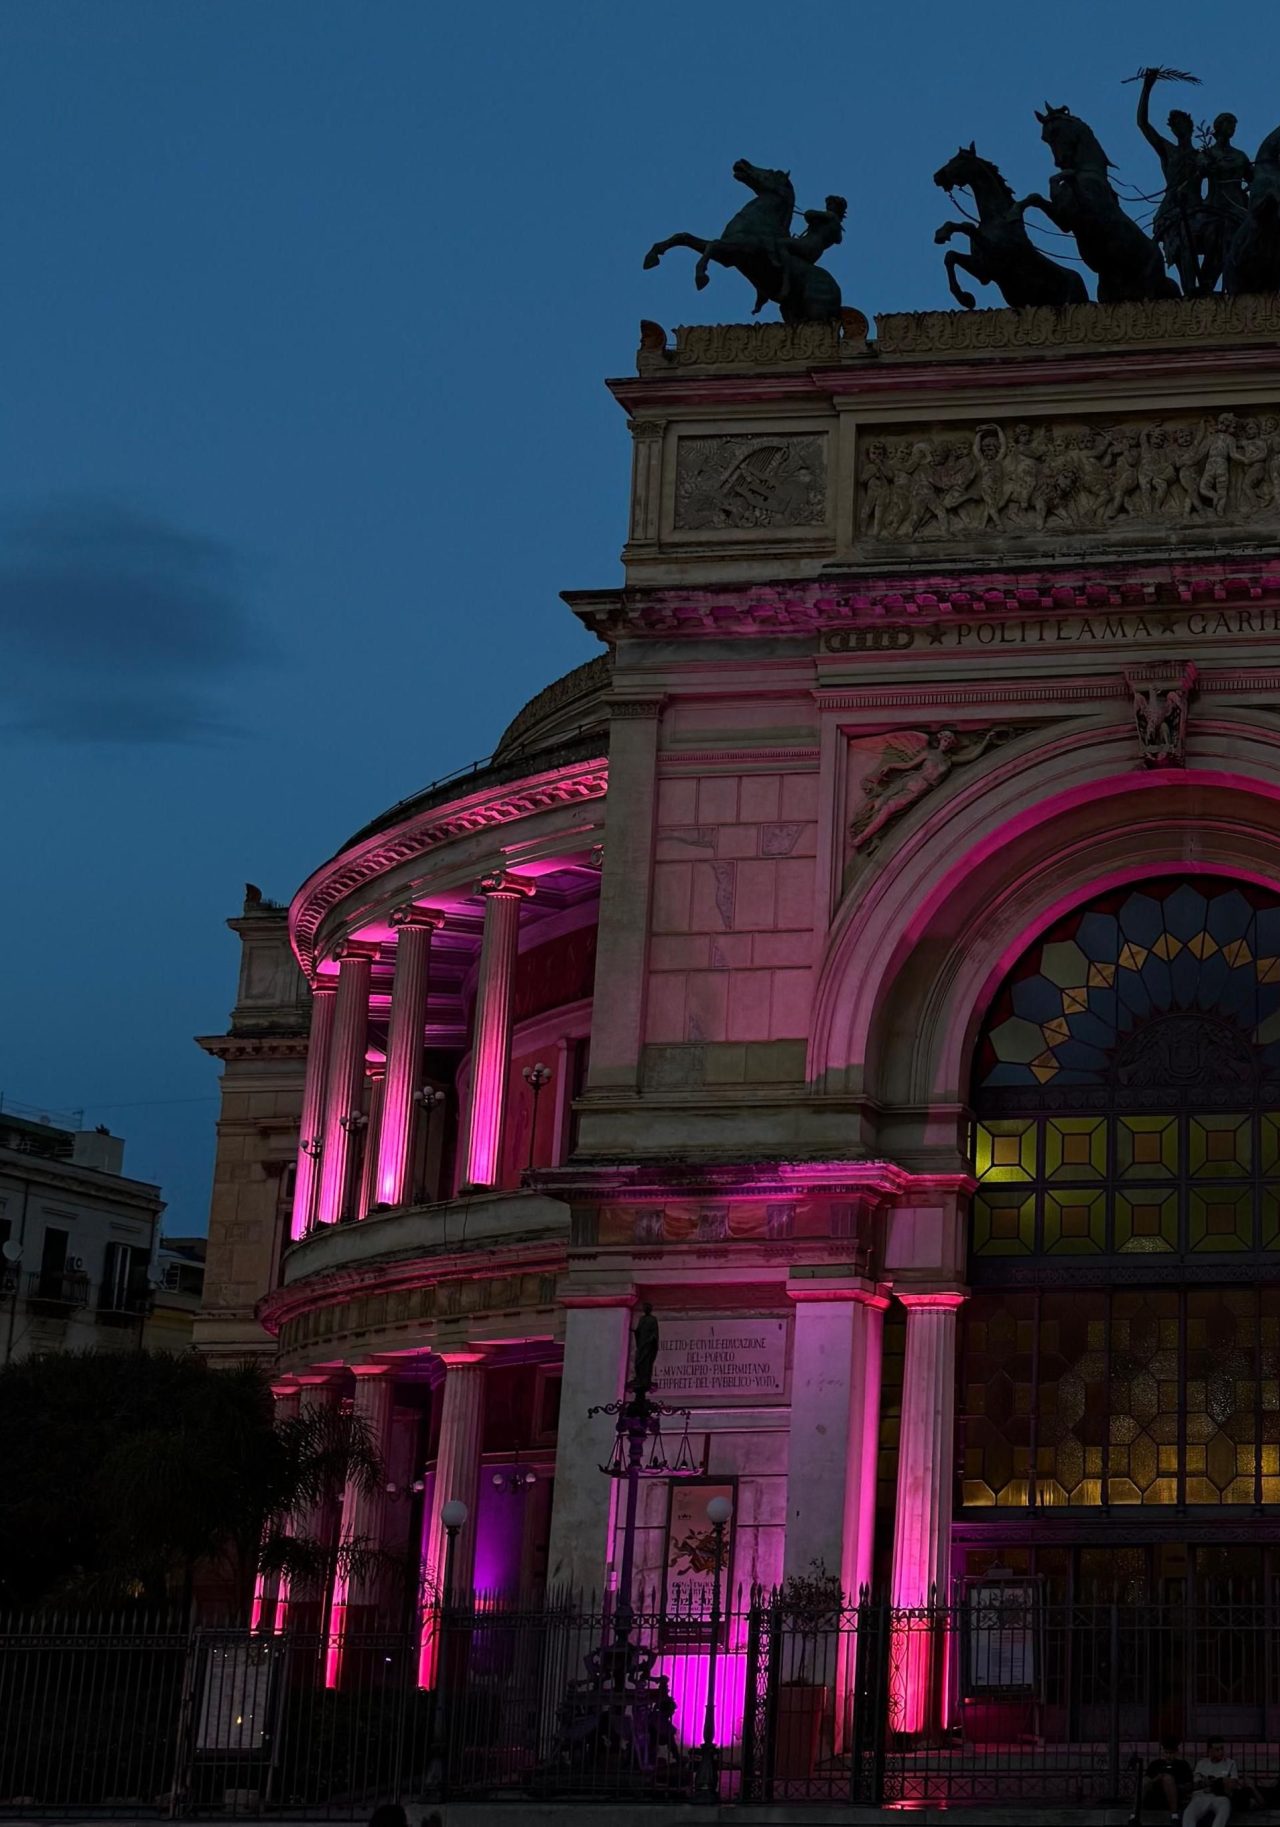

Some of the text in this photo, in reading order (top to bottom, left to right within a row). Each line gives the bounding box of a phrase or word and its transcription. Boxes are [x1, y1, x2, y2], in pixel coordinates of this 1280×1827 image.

[955, 615, 1153, 646] POLITEAMA
[663, 1363, 709, 1376] MVNICIPIO
[712, 1362, 770, 1375] PALERMITANO
